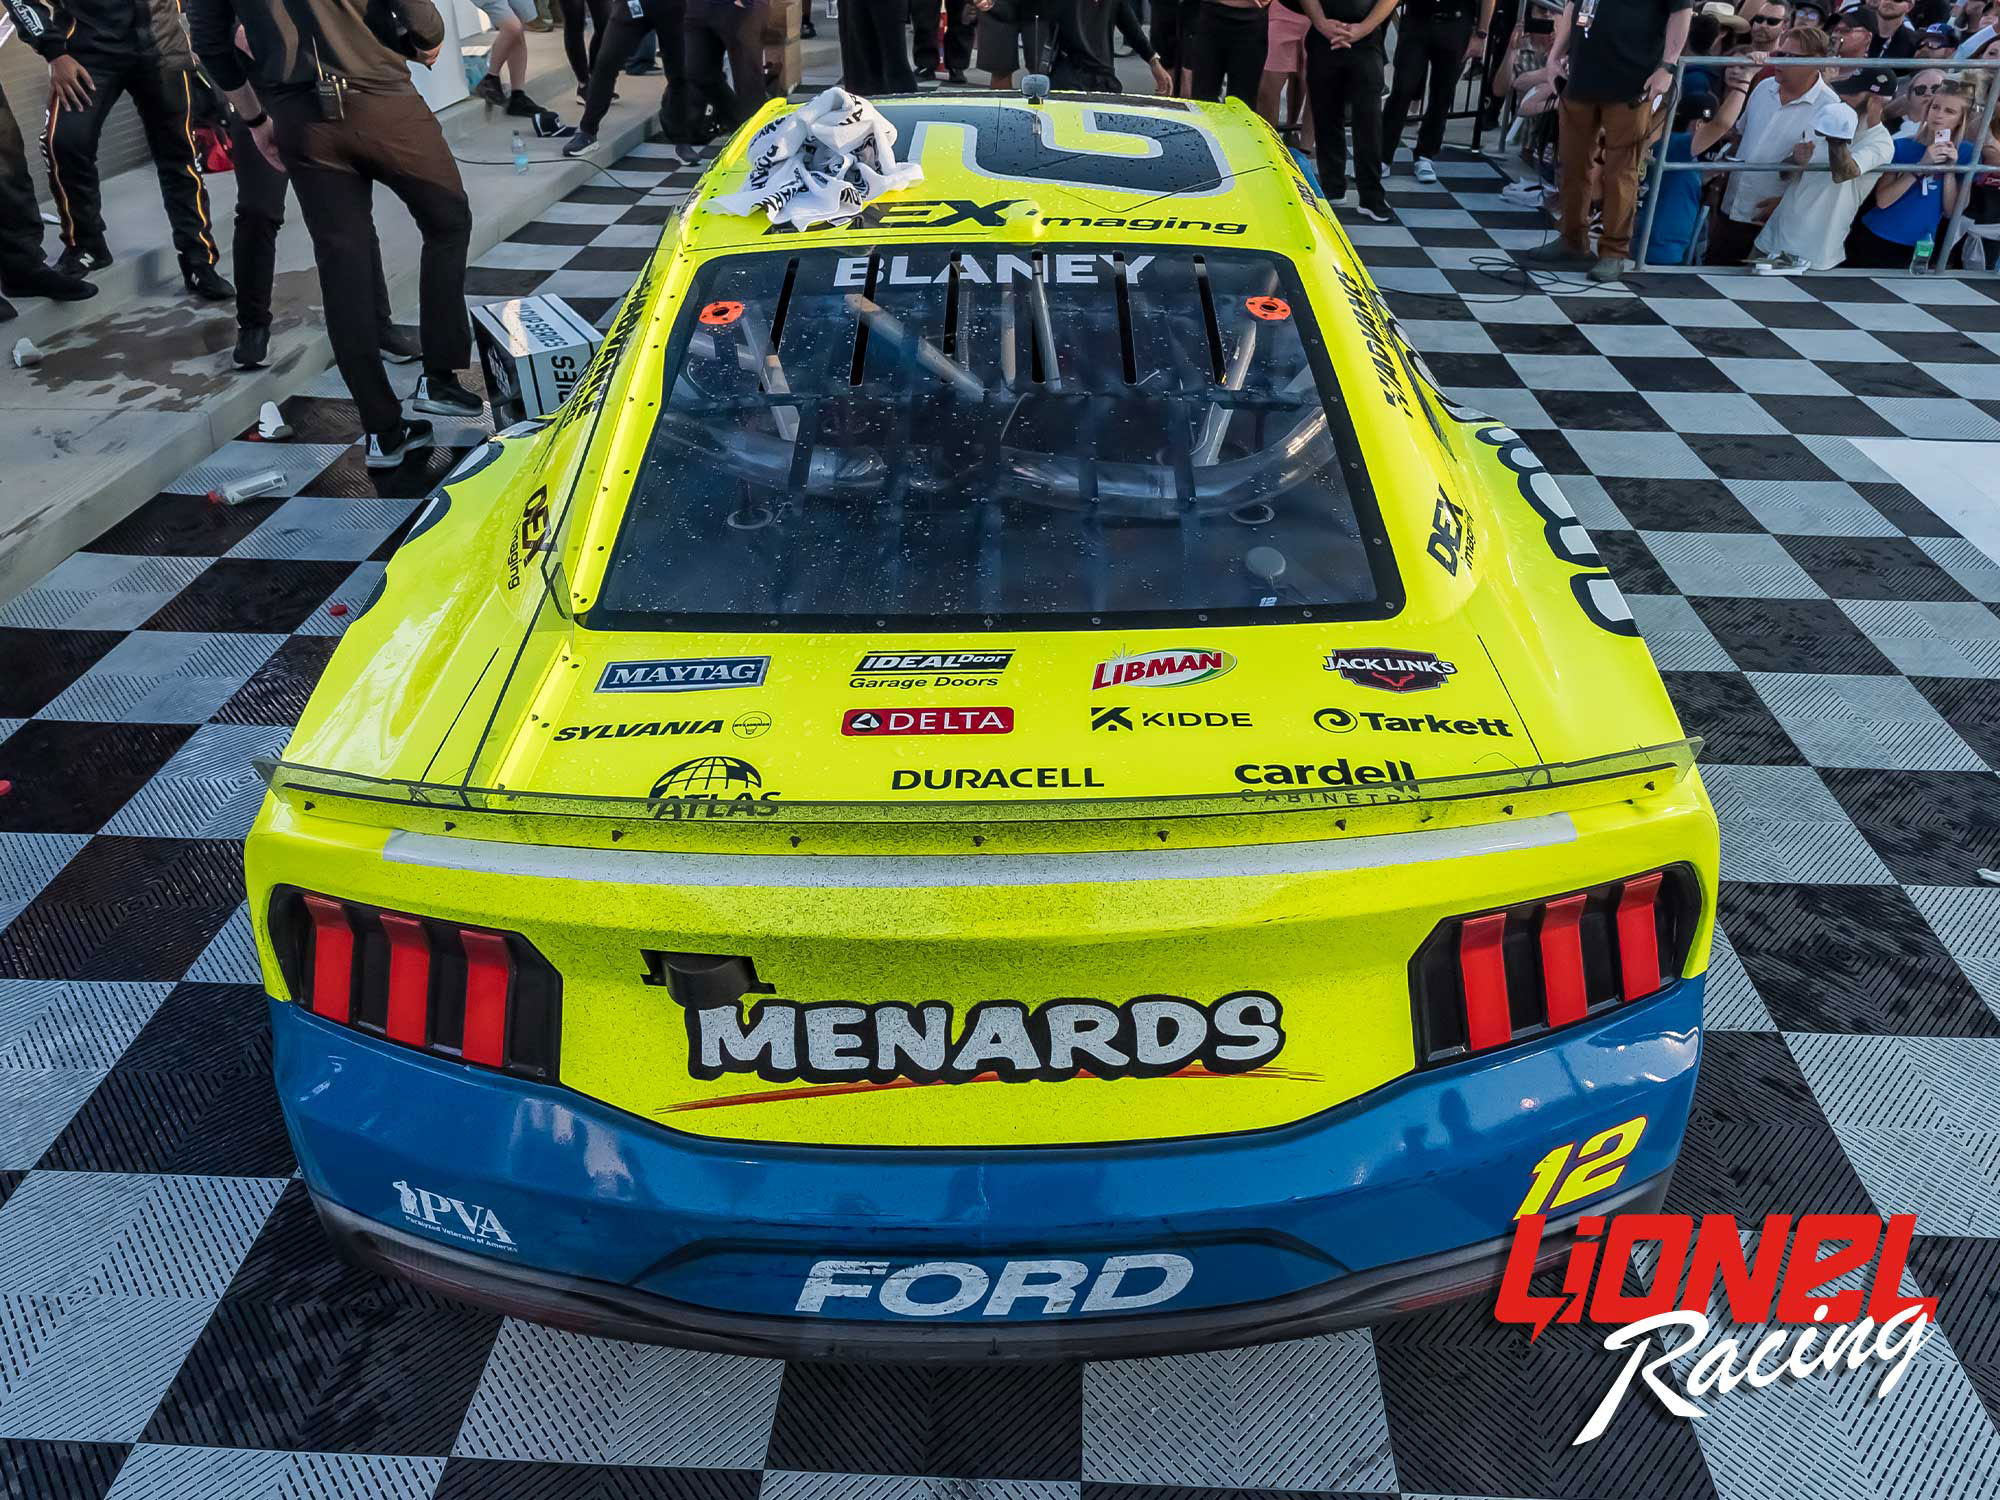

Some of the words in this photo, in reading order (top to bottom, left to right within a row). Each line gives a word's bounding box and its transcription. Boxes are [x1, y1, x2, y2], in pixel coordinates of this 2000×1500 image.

[762, 200, 1028, 237] EX
[833, 253, 1156, 288] BLANEY
[522, 483, 559, 568] DEX
[1426, 483, 1464, 577] DEX
[608, 662, 759, 685] MAYTAG
[862, 655, 961, 670] IDEAL
[957, 654, 1007, 664] Door
[1092, 652, 1223, 691] LIBMAN
[1322, 655, 1386, 672] JACK
[1383, 657, 1458, 675] LINK'S
[848, 677, 928, 690] Garage
[934, 676, 999, 688] Doors
[553, 719, 724, 742] SYLVANIA
[888, 711, 1005, 731] DELTA
[1141, 711, 1254, 727] KIDDE
[1360, 711, 1514, 738] Tarkett
[891, 766, 1105, 790] DURACELL
[1234, 757, 1421, 793] cardell
[654, 790, 782, 820] ATLAS
[690, 993, 1284, 1082] MENARDS
[1513, 1115, 1648, 1220] 12
[414, 1187, 517, 1245] PVA
[795, 1253, 1194, 1317] FORD
